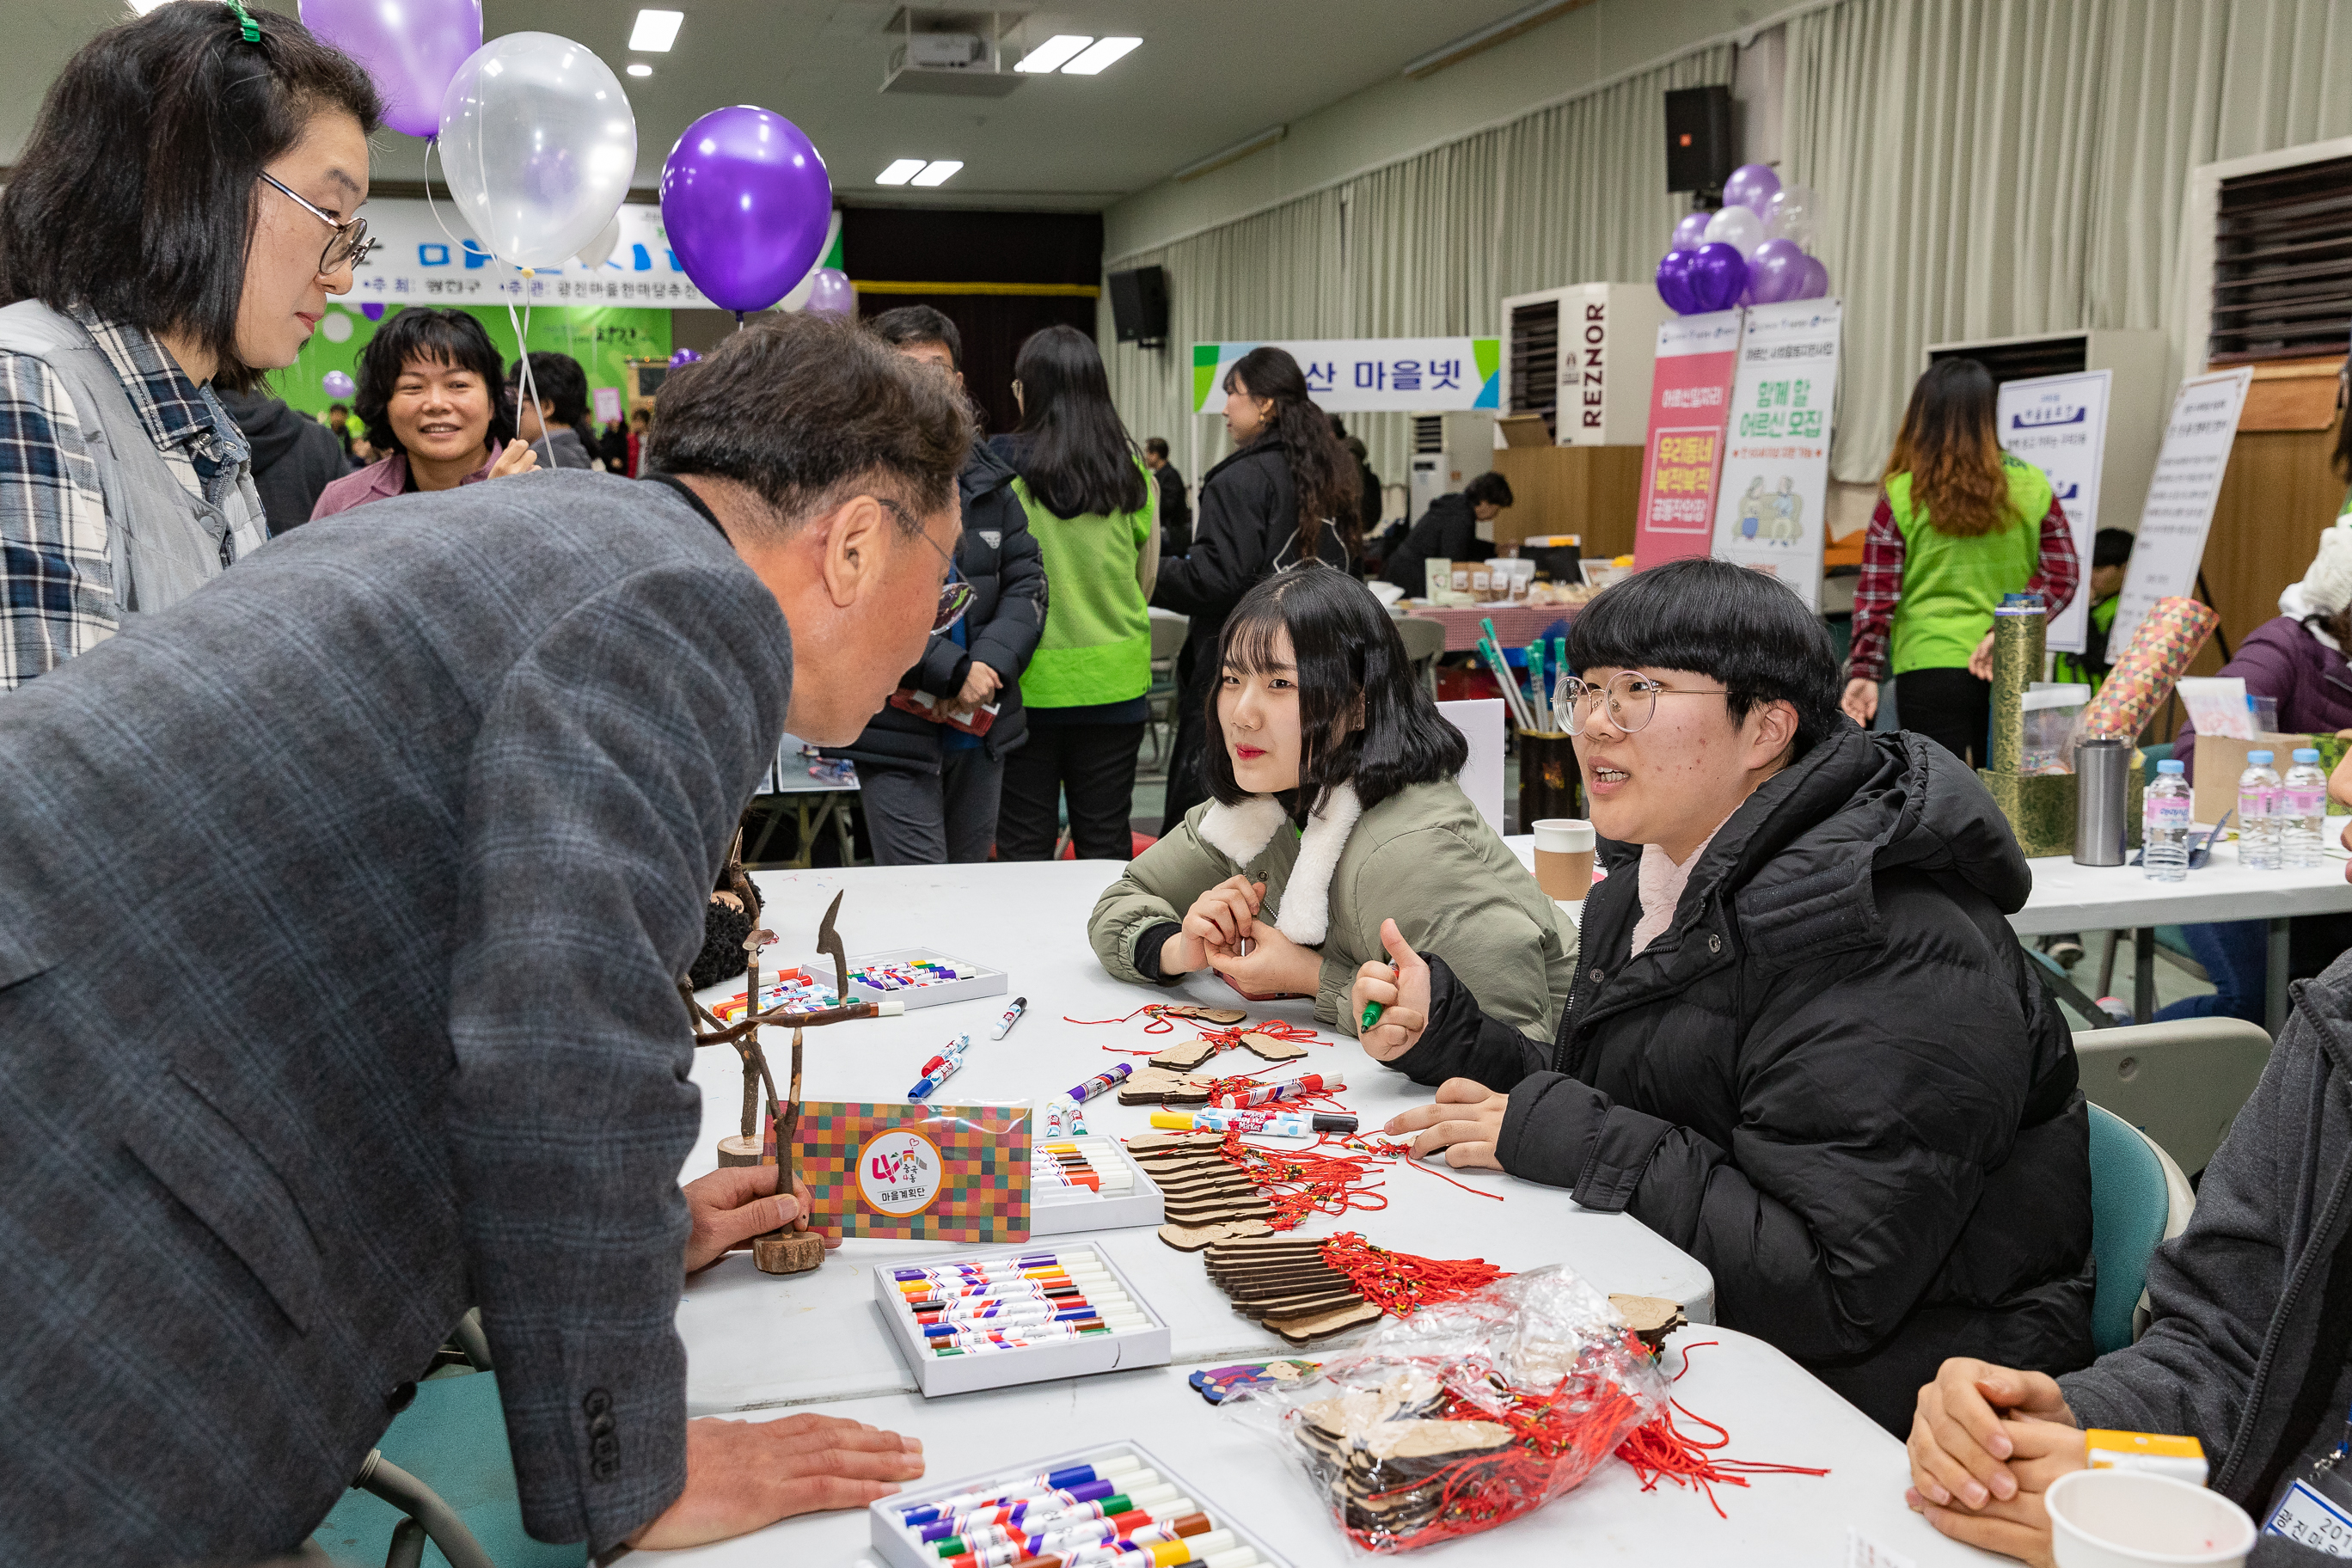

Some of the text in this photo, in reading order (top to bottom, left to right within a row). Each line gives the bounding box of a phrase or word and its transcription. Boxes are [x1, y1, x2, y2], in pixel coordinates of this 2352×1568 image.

[1355, 358, 1460, 391] 마을넷
[1583, 303, 1605, 428] REZNOR
[1756, 378, 1810, 408] 함께 할
[1739, 409, 1824, 438] 어르신 모집
[1239, 1122, 1262, 1132] Marker
[903, 1163, 919, 1174] 중곡
[881, 1187, 926, 1202] 마을계획단
